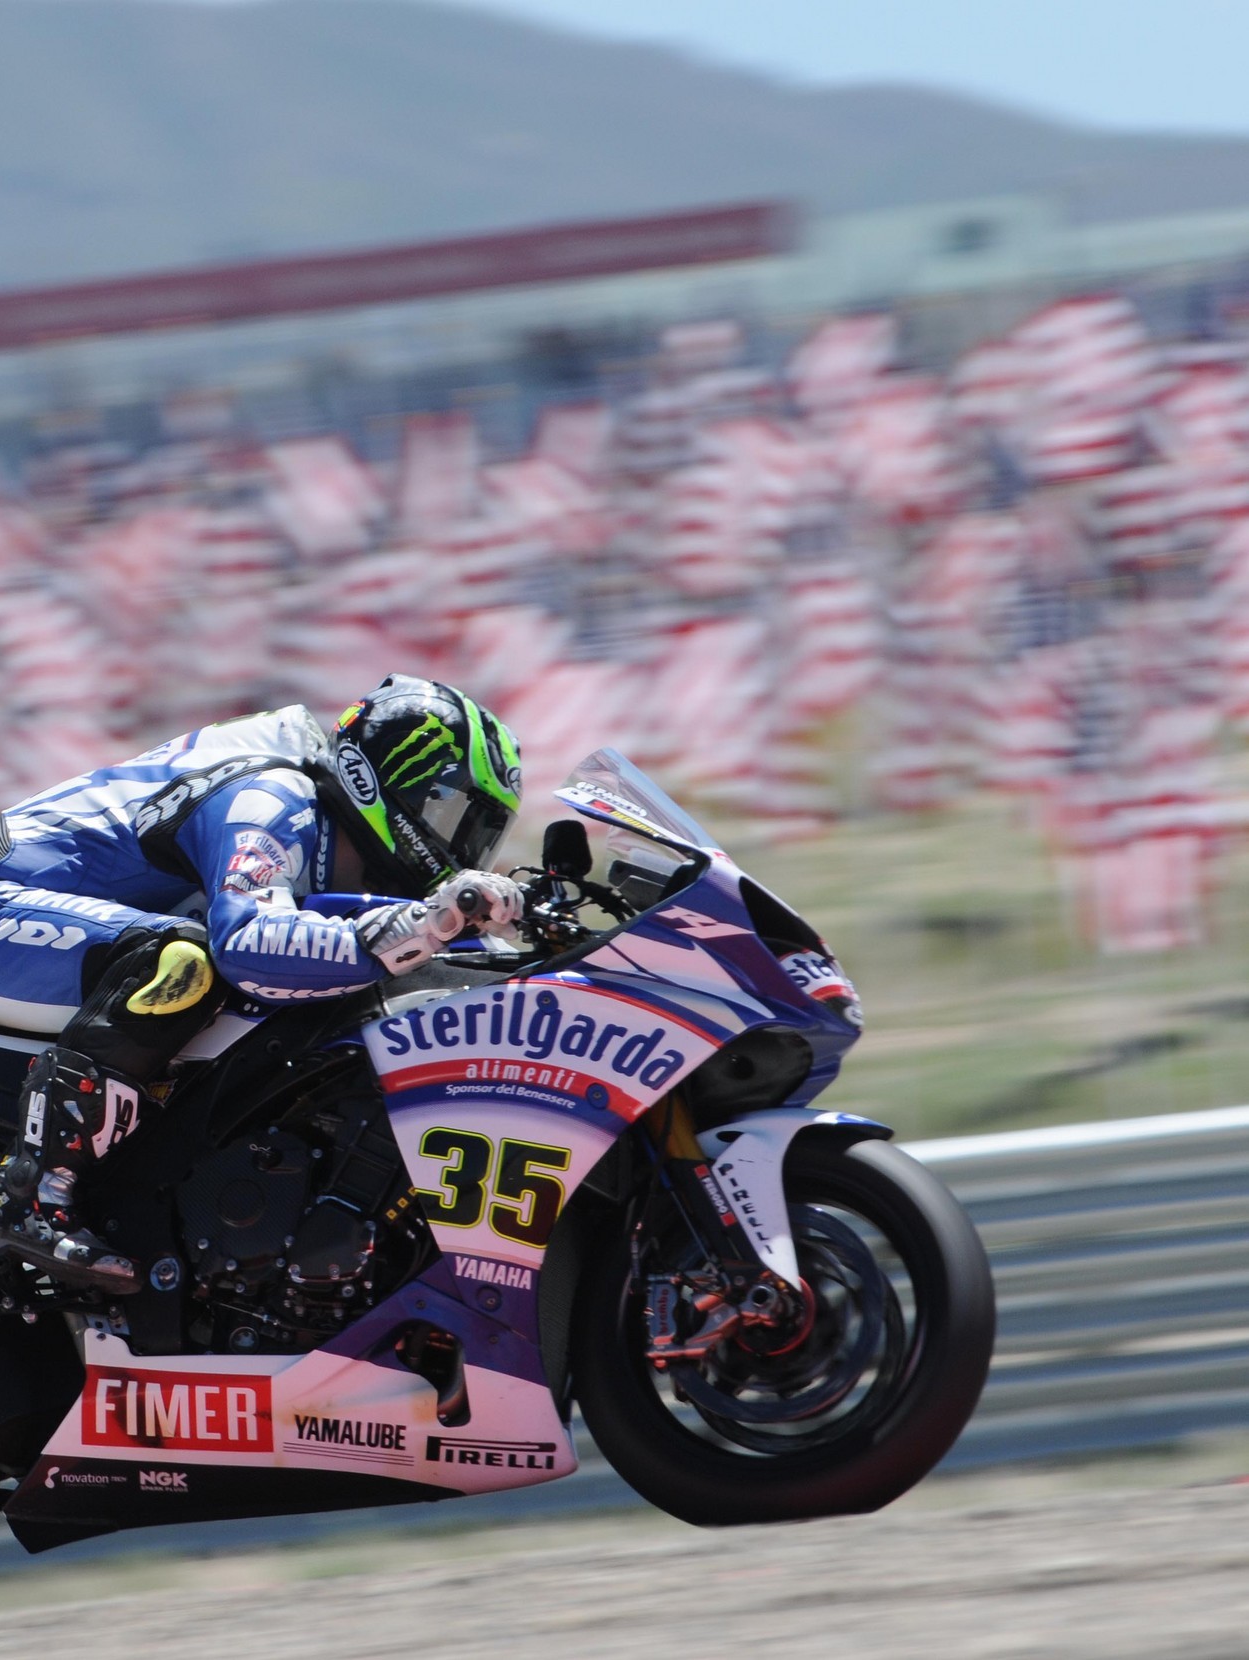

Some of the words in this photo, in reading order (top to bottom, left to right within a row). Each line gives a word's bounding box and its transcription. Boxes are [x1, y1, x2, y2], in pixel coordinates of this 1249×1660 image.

[340, 751, 376, 798] Arai
[394, 813, 442, 875] MONSTER
[224, 917, 358, 965] YAMAHA
[445, 1083, 493, 1096] Sponsor
[496, 1083, 515, 1095] del
[517, 1086, 577, 1109] Benessere
[465, 1060, 576, 1091] alimenti
[418, 1126, 572, 1249] 35
[718, 1162, 773, 1255] PIRELLI
[455, 1256, 532, 1290] YAMAHA
[94, 1378, 258, 1442] FIMER
[294, 1414, 407, 1451] YAMALUBE
[425, 1435, 555, 1470] PIRELLI
[139, 1470, 188, 1487] NGK
